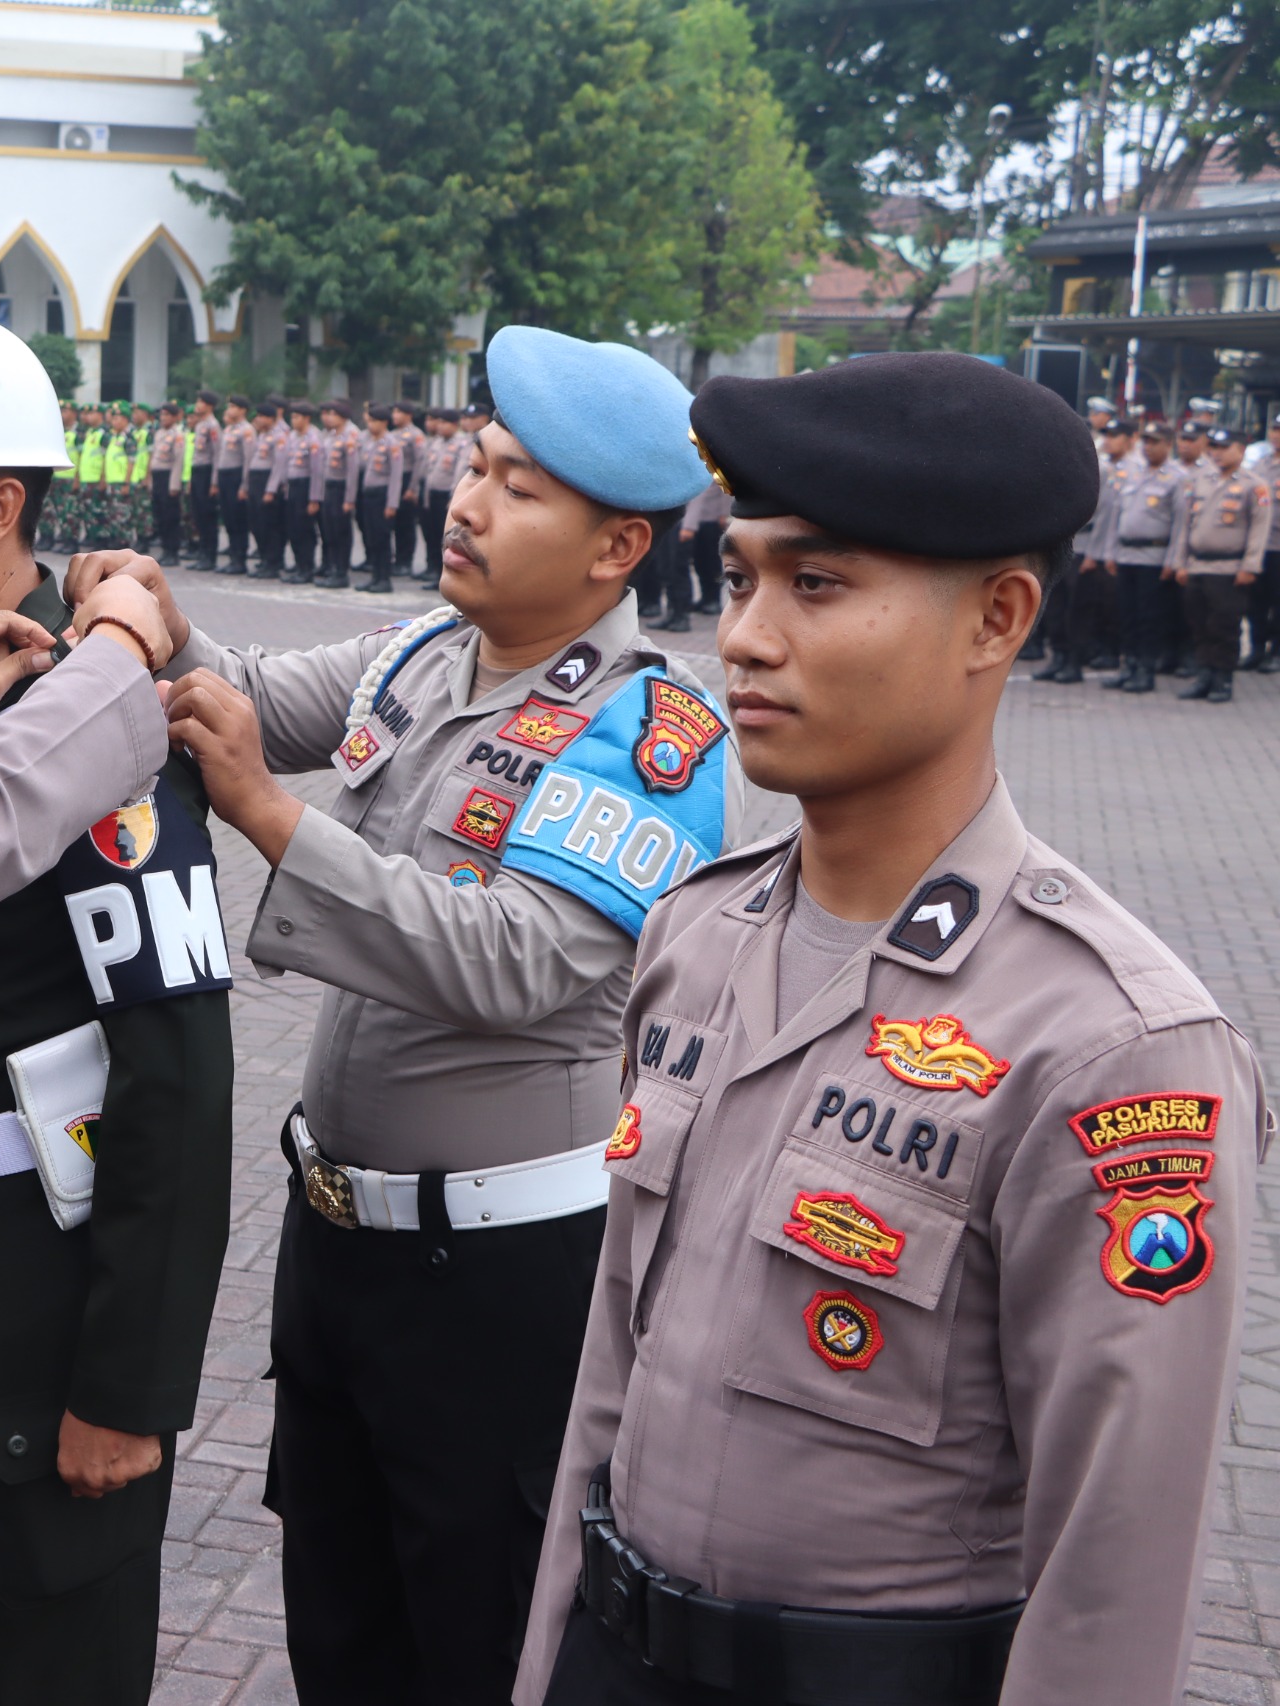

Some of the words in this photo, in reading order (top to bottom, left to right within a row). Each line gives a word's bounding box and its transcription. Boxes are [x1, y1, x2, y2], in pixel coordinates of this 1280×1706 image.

[659, 686, 717, 730] POLRES
[659, 709, 681, 723] JAWA
[681, 720, 703, 742] TIMUR
[661, 695, 711, 732] PASURUAN
[466, 741, 546, 787] POLR
[64, 864, 232, 1005] PM
[919, 1071, 951, 1080] POLRI
[811, 1085, 960, 1180] POLRI
[1091, 1114, 1207, 1147] PASURUAN
[1096, 1099, 1200, 1132] POLRES
[1107, 1160, 1151, 1182] JAWA
[1157, 1157, 1202, 1175] TIMUR
